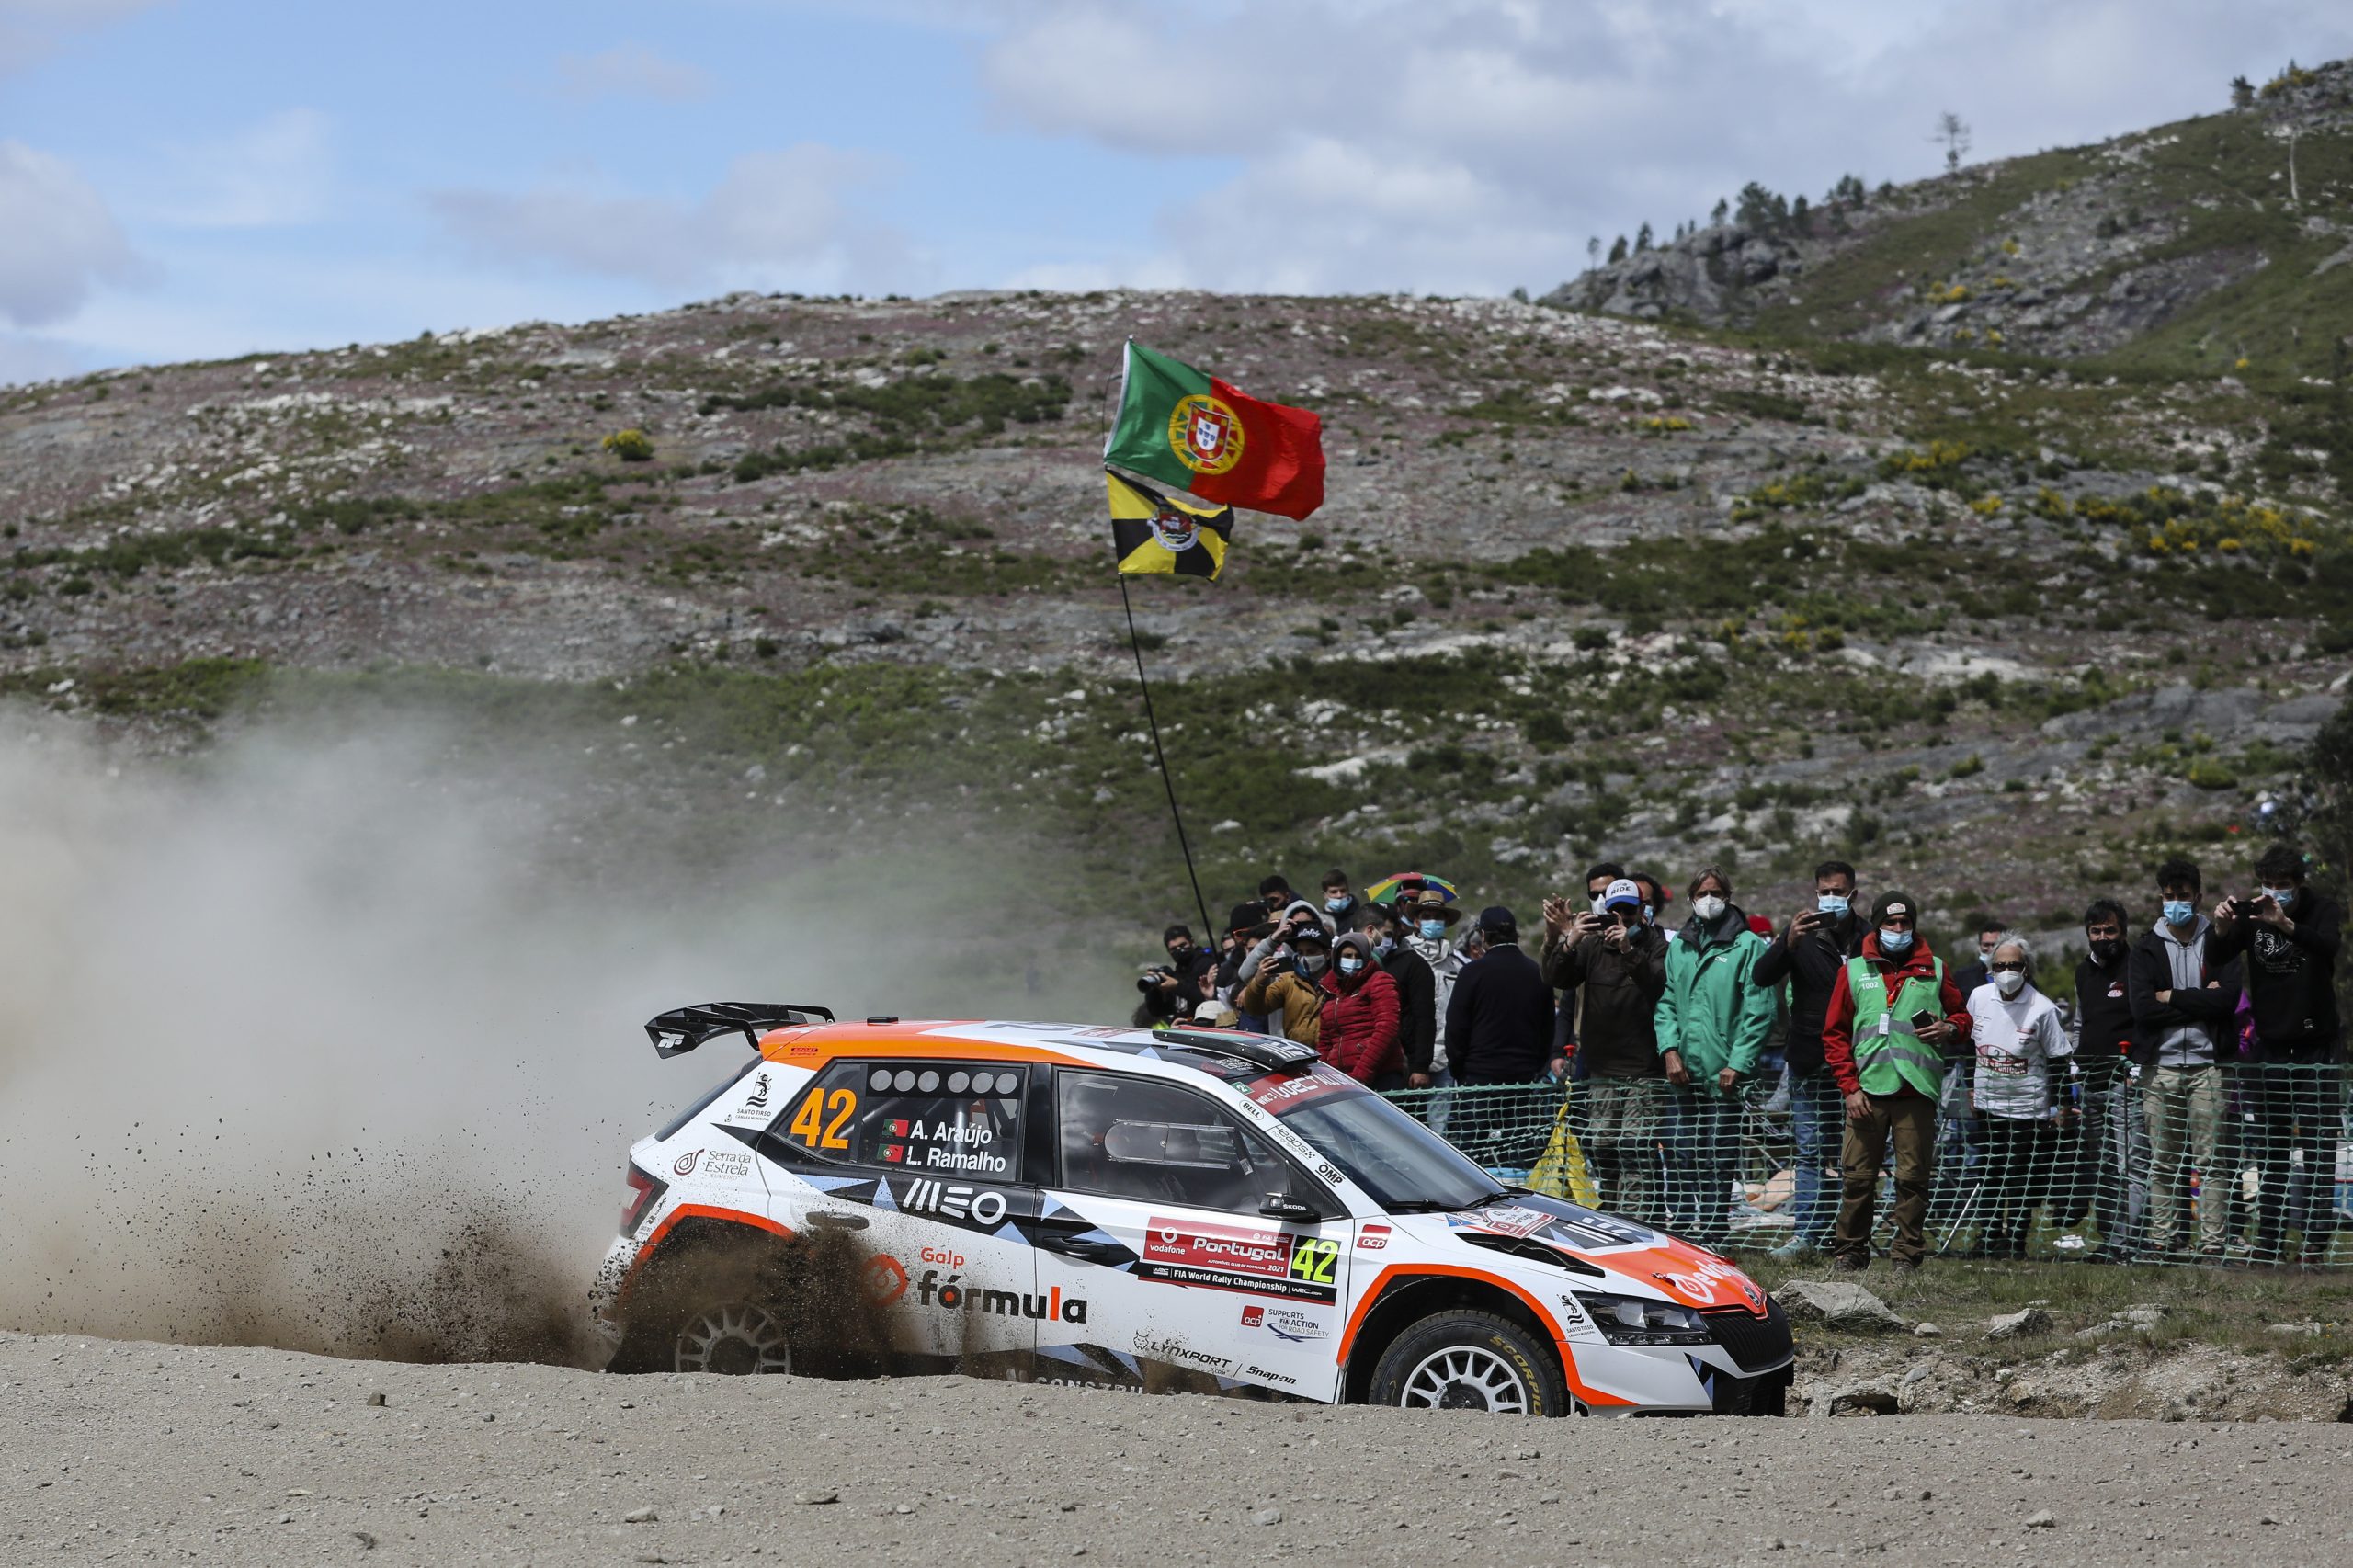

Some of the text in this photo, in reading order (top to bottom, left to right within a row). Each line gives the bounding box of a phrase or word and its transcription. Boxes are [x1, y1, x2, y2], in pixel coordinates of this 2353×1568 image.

[1862, 982, 1879, 990] 1002
[790, 1087, 858, 1150] 42
[1242, 1102, 1261, 1119] BELL
[910, 1119, 992, 1149] A. Araújo
[708, 1151, 751, 1163] Serra da
[906, 1146, 1006, 1172] L. Ramalho
[705, 1161, 749, 1176] Estrela
[1318, 1164, 1344, 1184] OMP
[902, 1177, 1007, 1225] MEO
[1149, 1244, 1186, 1256] vodafone
[1192, 1236, 1285, 1262] Portugal
[1362, 1237, 1385, 1248] acp
[920, 1247, 965, 1269] Galp
[1291, 1238, 1339, 1284] 42
[1267, 1265, 1285, 1273] 2021
[1174, 1269, 1187, 1278] FIA
[1188, 1271, 1211, 1281] World
[1212, 1274, 1232, 1286] Rally
[1233, 1278, 1287, 1292] Championship
[917, 1270, 1088, 1324] fórmula
[1268, 1309, 1304, 1319] SUPPORTS
[1290, 1320, 1319, 1329] ACTION
[1306, 1329, 1329, 1337] SAFETY
[1246, 1366, 1297, 1384] Snap-on
